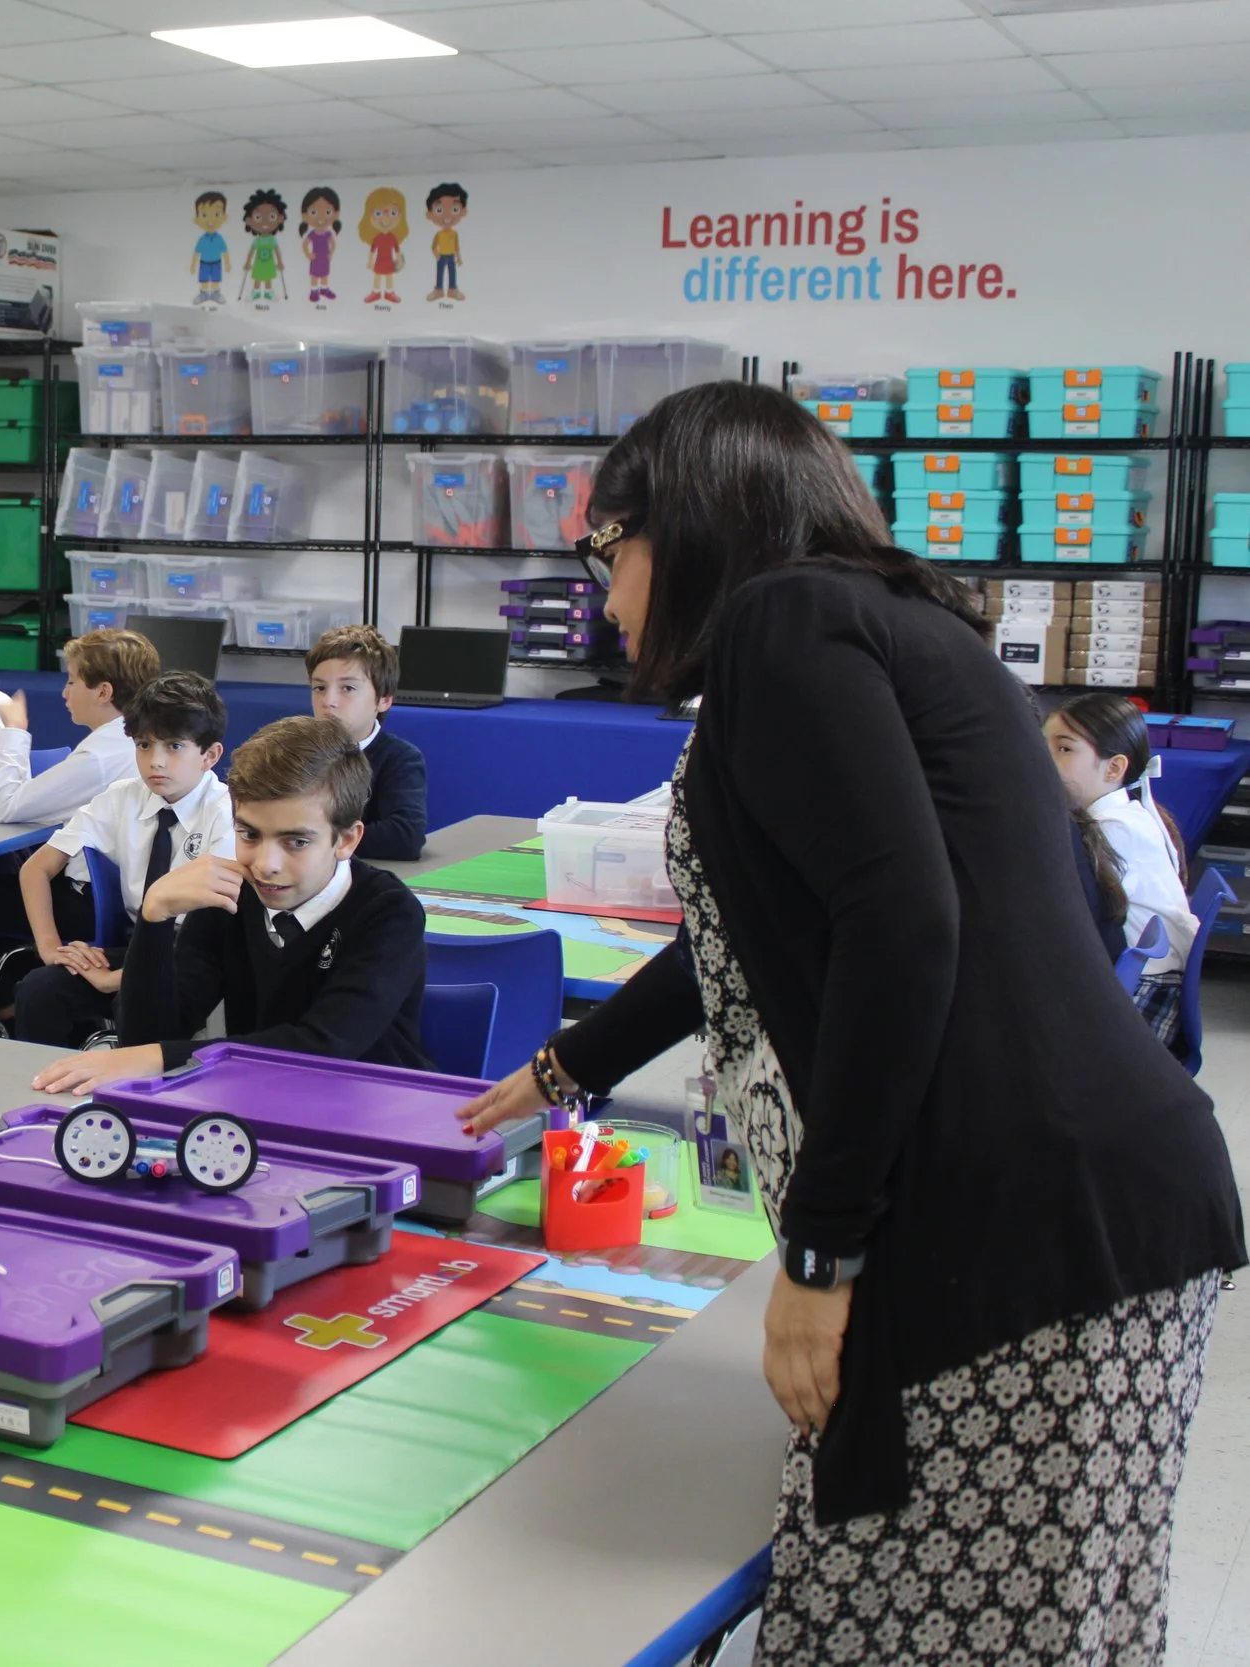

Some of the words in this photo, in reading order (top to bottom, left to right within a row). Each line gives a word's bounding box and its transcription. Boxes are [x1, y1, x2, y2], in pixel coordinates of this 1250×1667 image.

[661, 200, 867, 256] Learning
[880, 197, 919, 244] is
[683, 256, 882, 302] different
[896, 253, 1017, 300] here.
